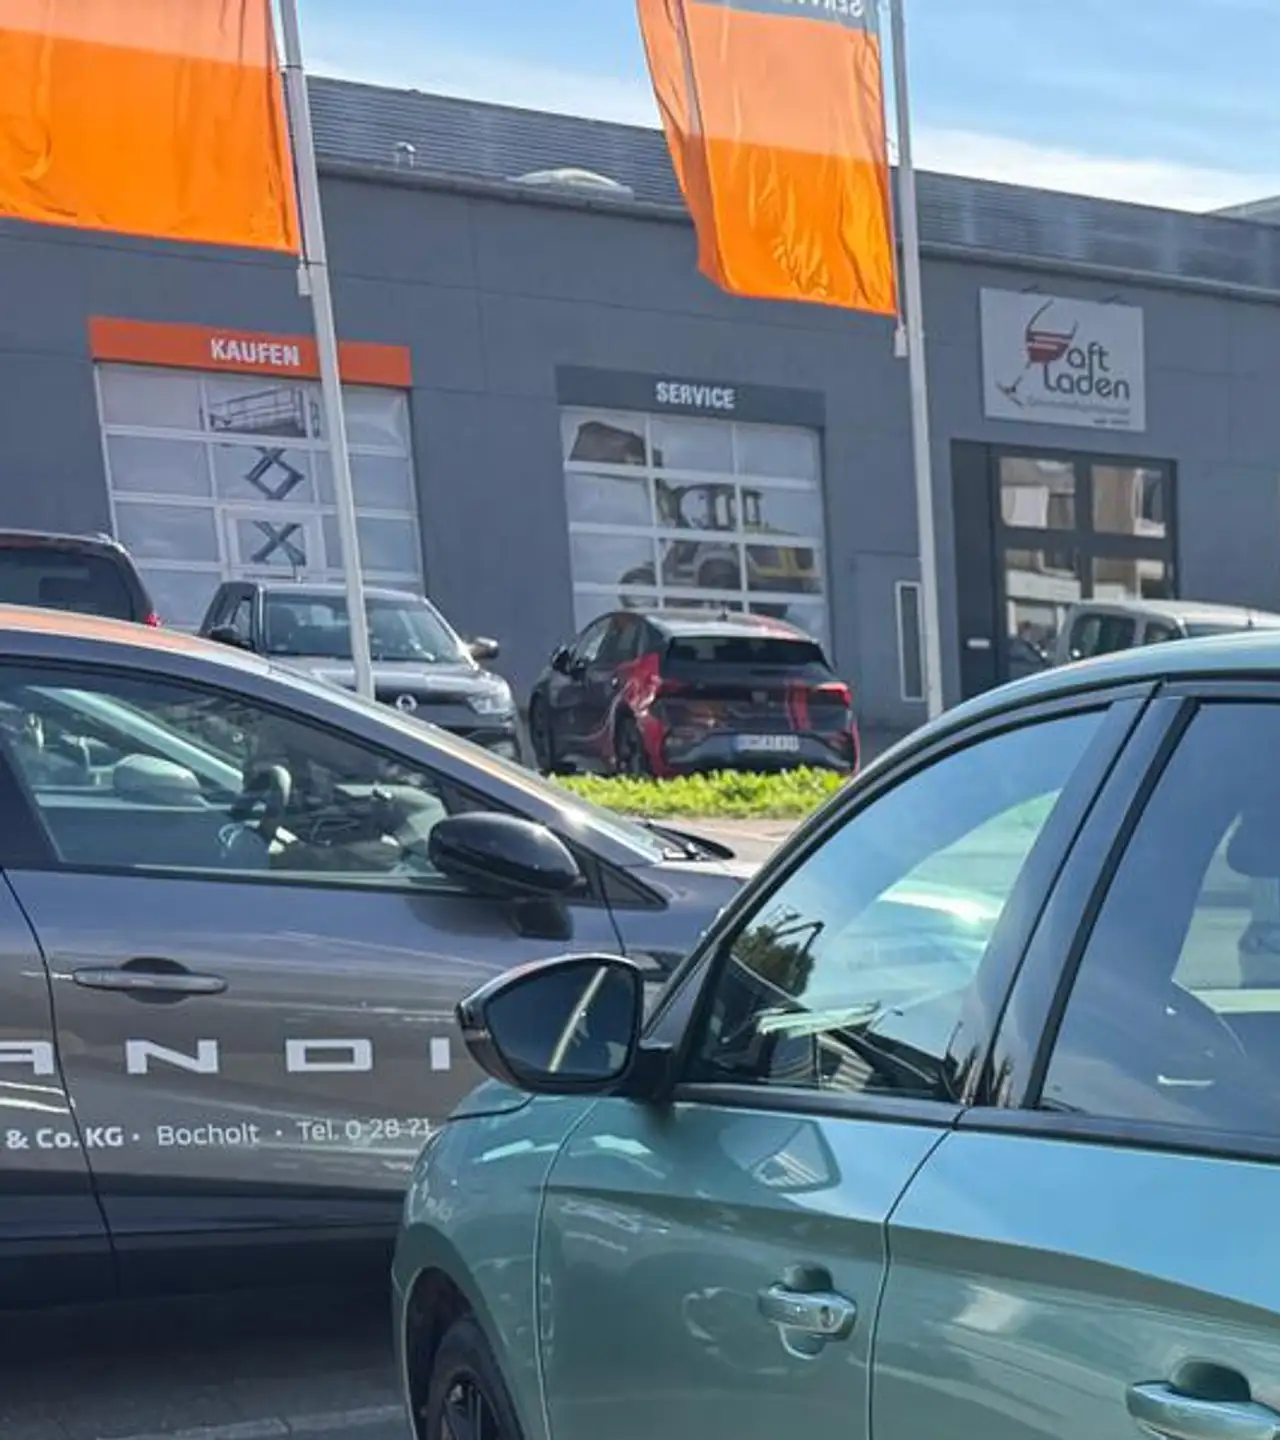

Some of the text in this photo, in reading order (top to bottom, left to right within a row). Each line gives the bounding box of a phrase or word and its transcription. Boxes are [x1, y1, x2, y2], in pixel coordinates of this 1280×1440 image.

[210, 337, 300, 368] KAUFEN
[655, 381, 735, 409] SERVICE
[6, 1129, 29, 1149] &
[36, 1127, 79, 1149] Co.
[86, 1126, 124, 1147] KG
[157, 1124, 260, 1146] Bocholt
[296, 1120, 340, 1141] Tel.
[345, 1119, 361, 1140] 0
[369, 1117, 400, 1139] 28
